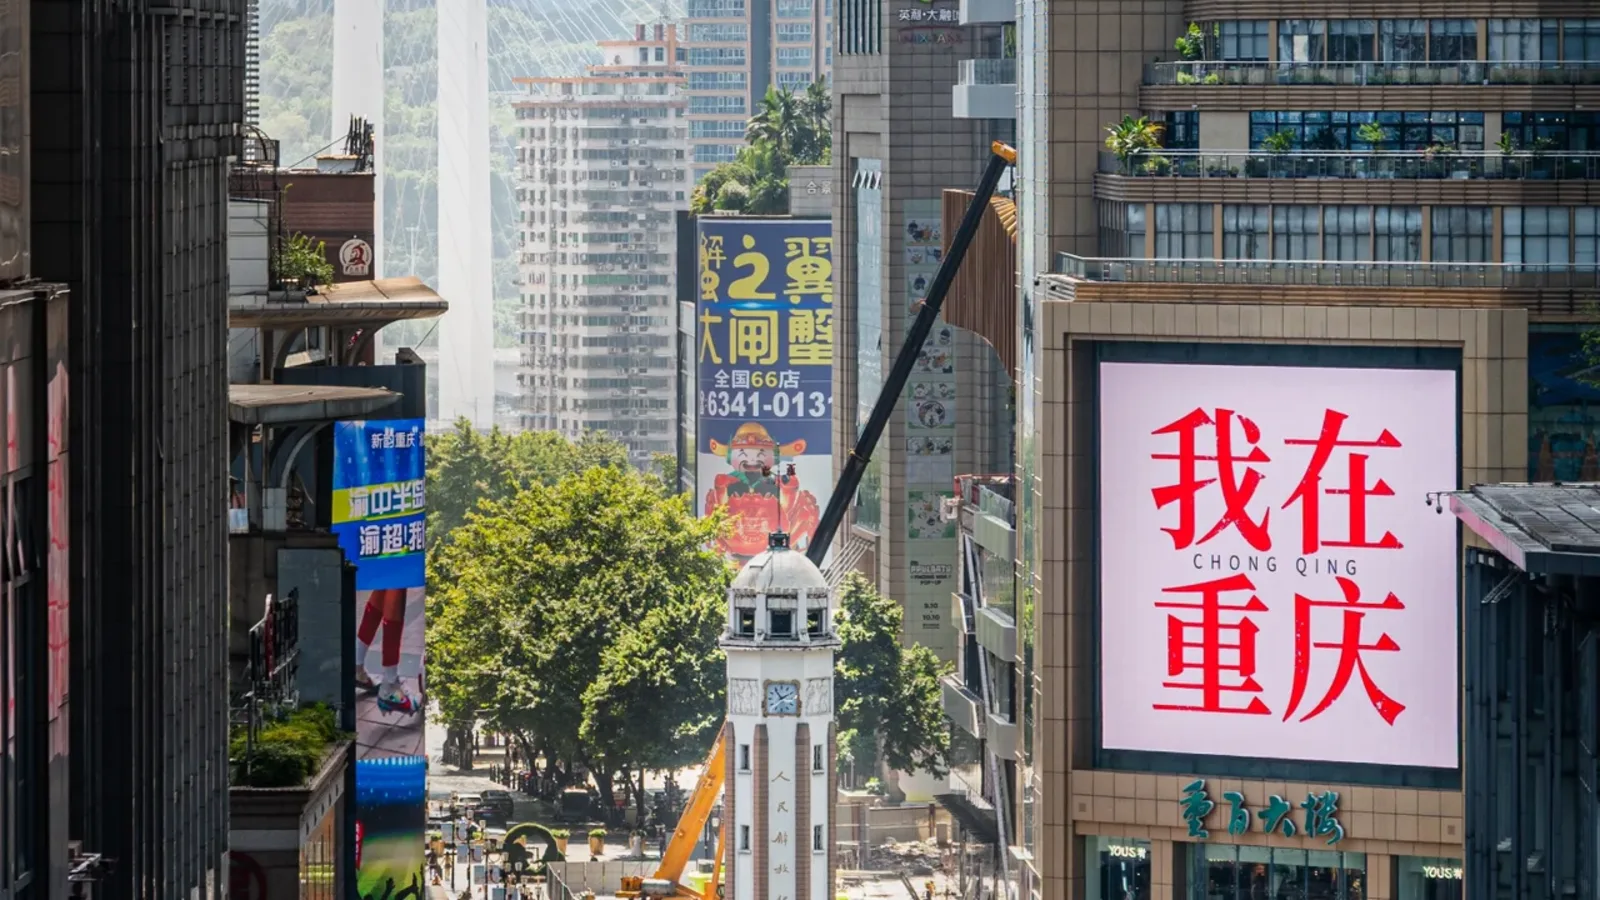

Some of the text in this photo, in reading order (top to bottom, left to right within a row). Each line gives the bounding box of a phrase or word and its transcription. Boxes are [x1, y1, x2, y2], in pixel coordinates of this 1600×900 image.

[700, 308, 832, 365] 大闸蟹
[714, 369, 800, 390] 全国66店
[1151, 407, 1404, 555] 我在
[1193, 553, 1358, 577] CHONG QING
[1153, 574, 1406, 726] 重庆
